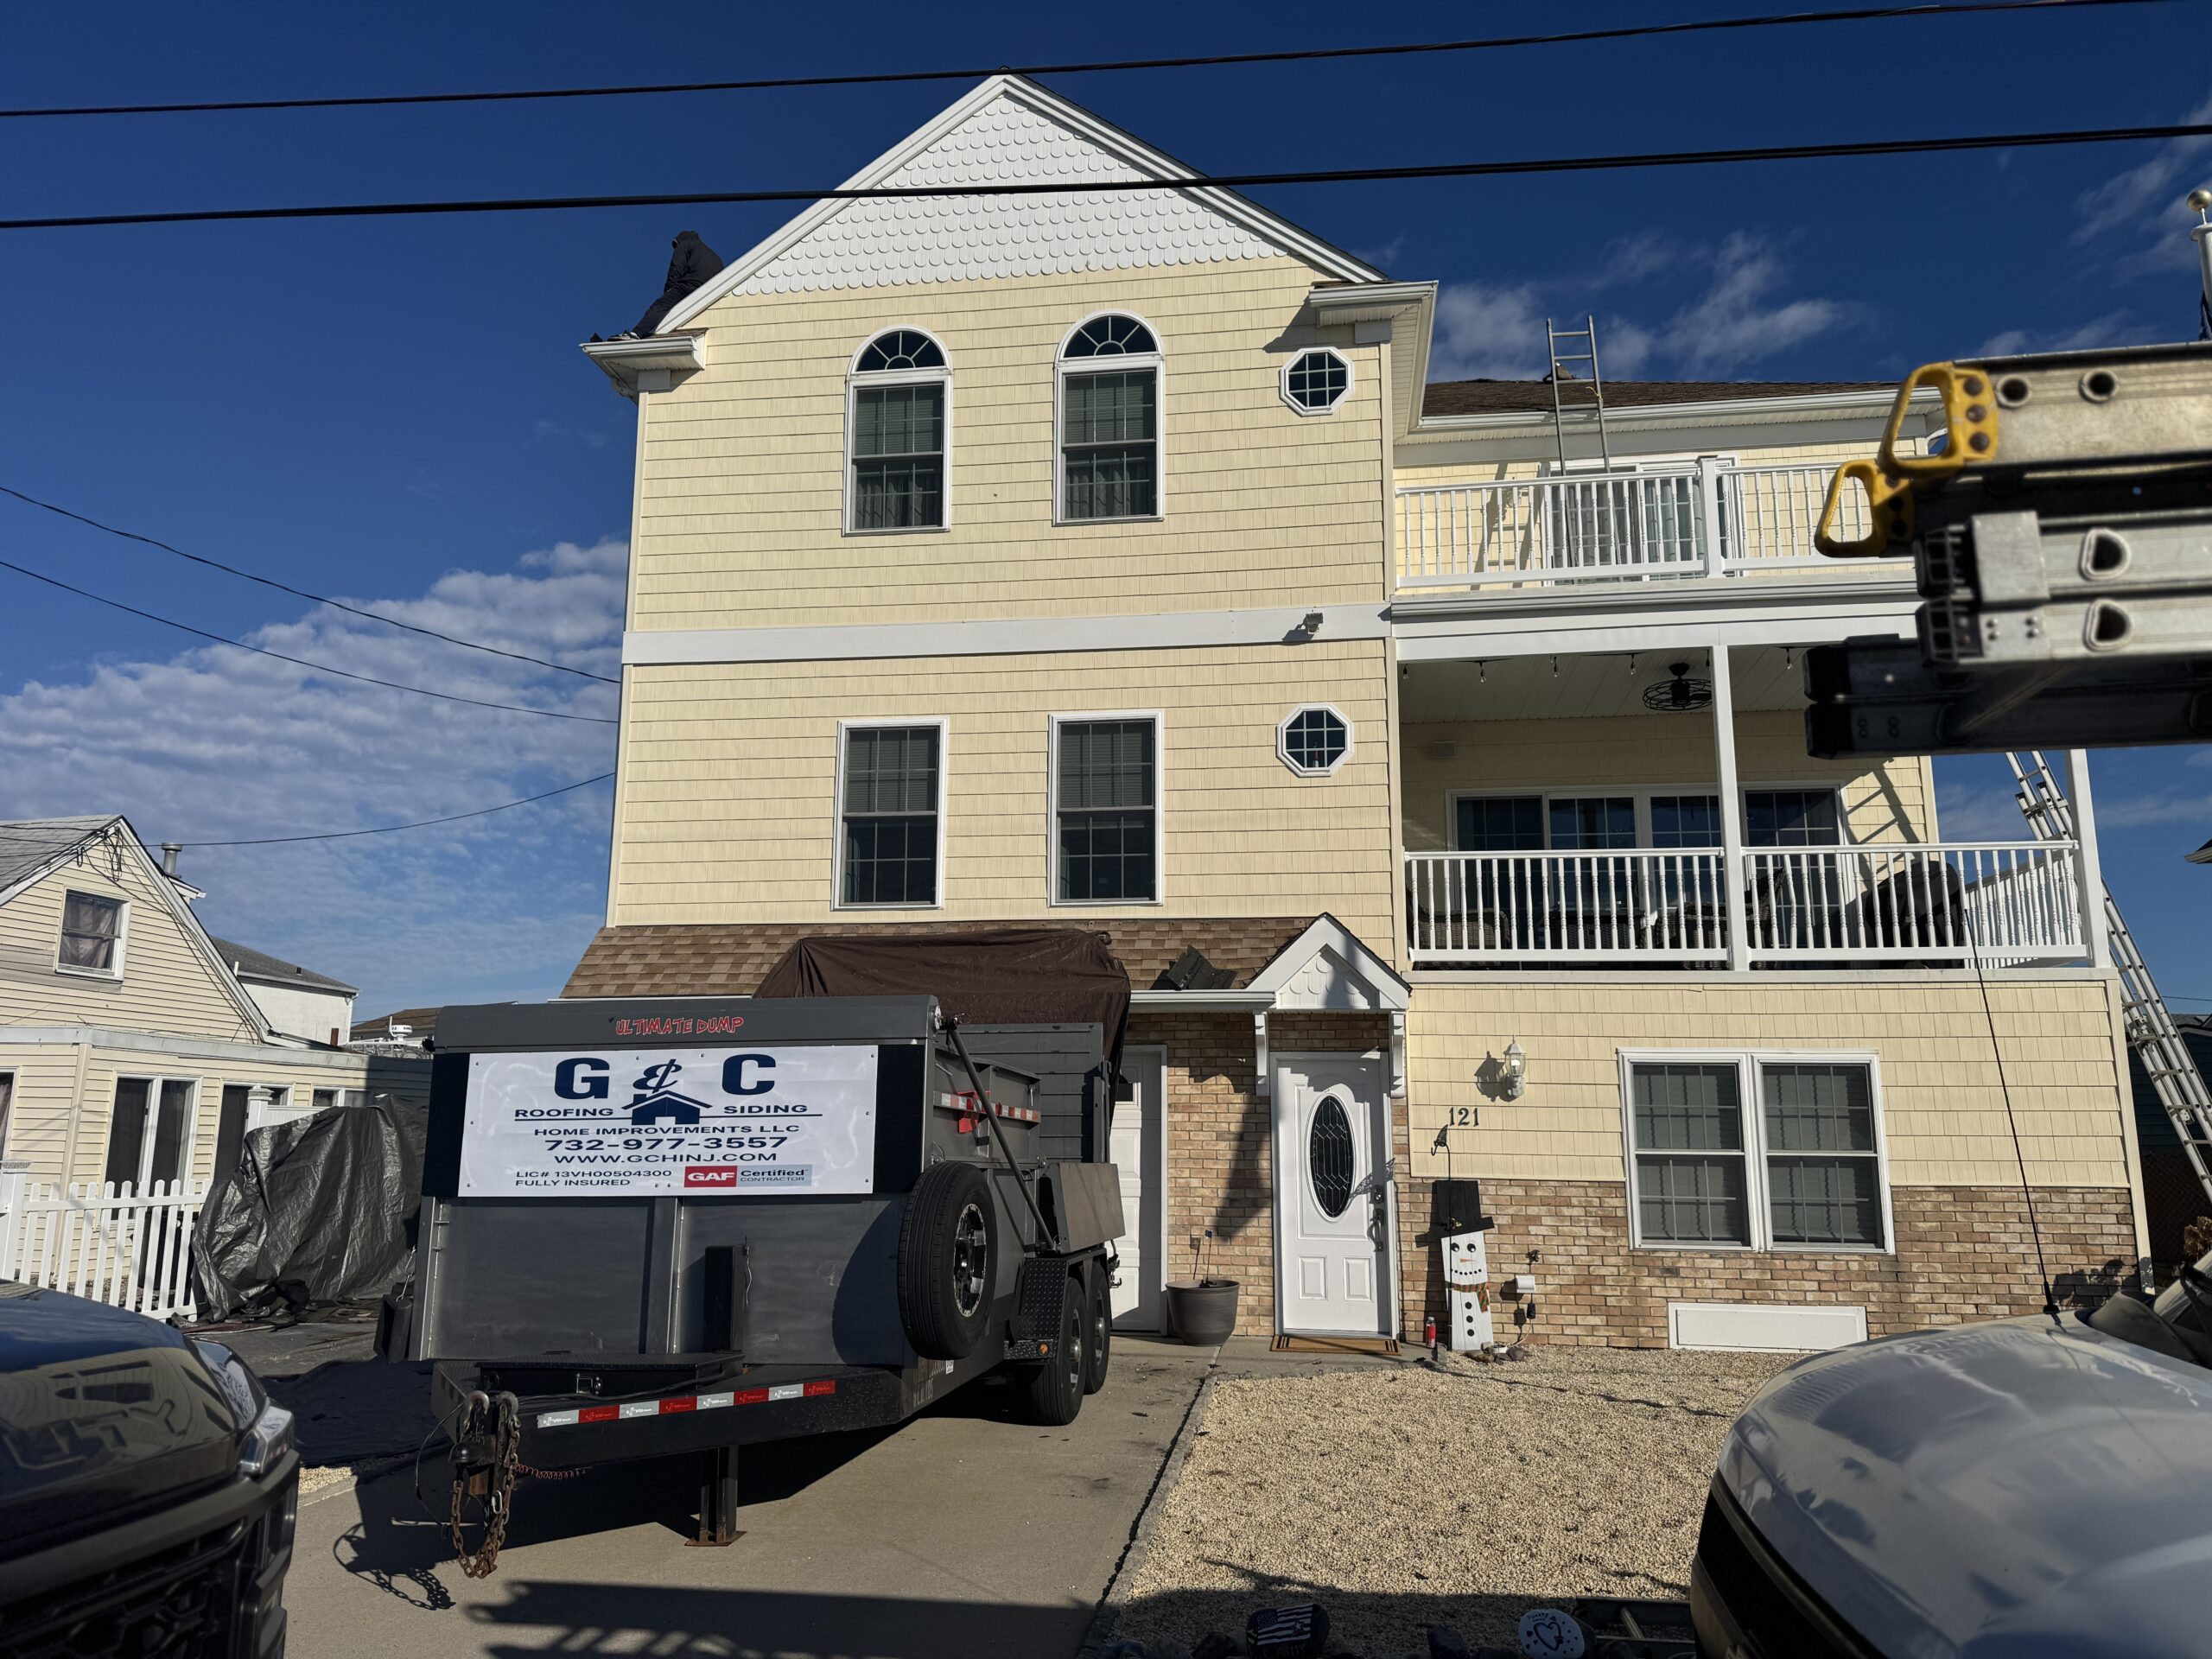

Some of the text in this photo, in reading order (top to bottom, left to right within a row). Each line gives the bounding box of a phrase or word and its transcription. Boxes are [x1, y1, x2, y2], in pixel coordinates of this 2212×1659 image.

[616, 1016, 745, 1036] ULTIMATE DUMP
[554, 1057, 610, 1100] G
[721, 1053, 777, 1096] C
[514, 1108, 614, 1117] ROOFING
[723, 1103, 809, 1114] SIDING
[1449, 1107, 1480, 1128] 121
[534, 1125, 800, 1136] HOME IMPROVEMENTS LLC
[544, 1136, 788, 1151] 732-977-3557
[554, 1153, 777, 1164] WWW.GCHINJ.COM
[554, 1170, 672, 1179] 13VH00504300
[688, 1172, 735, 1182] GAF
[741, 1168, 804, 1177] Certified
